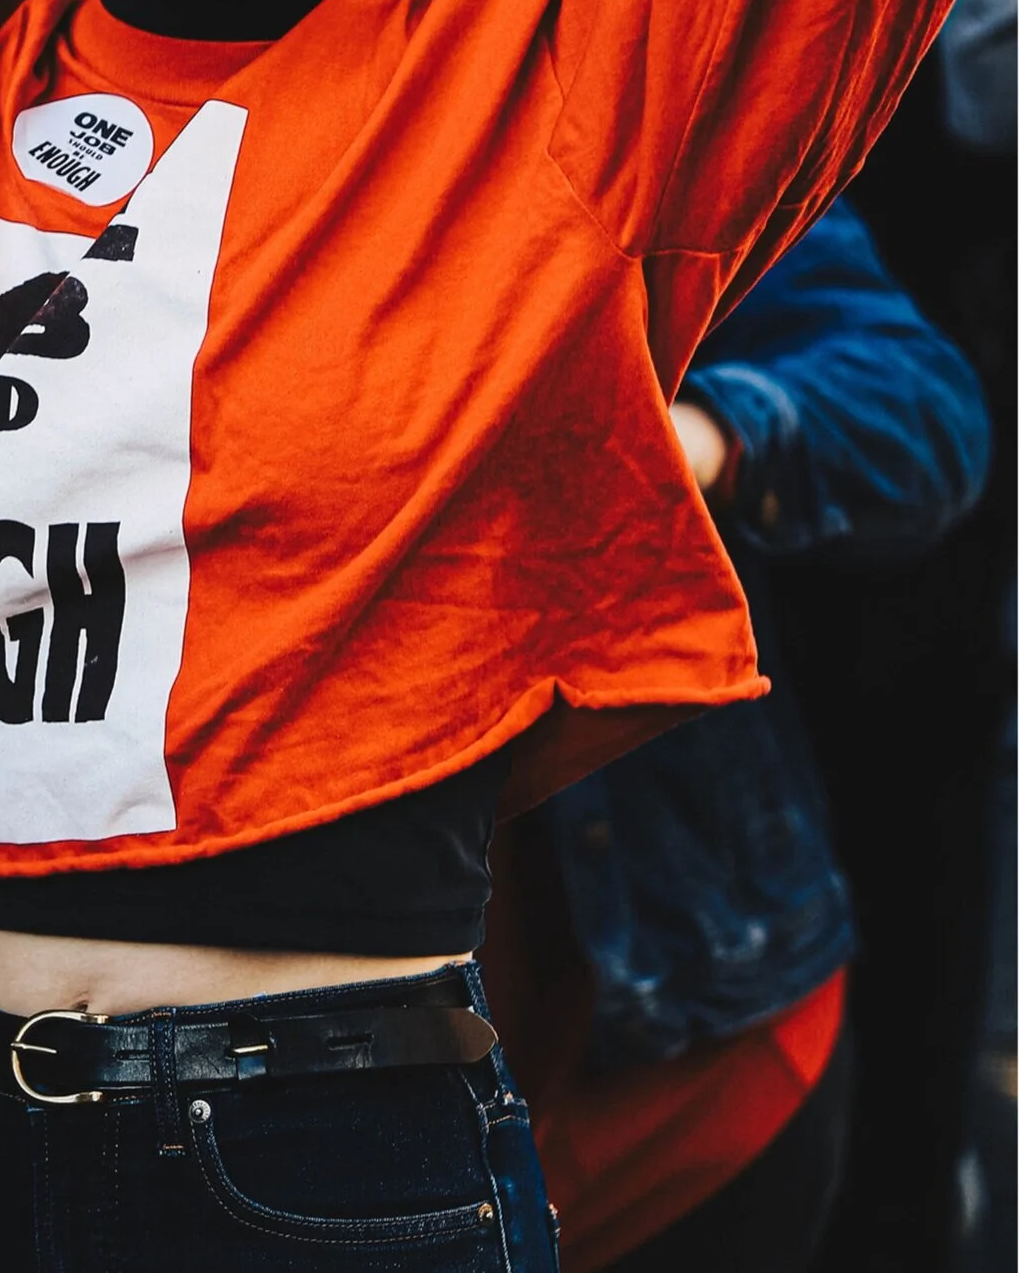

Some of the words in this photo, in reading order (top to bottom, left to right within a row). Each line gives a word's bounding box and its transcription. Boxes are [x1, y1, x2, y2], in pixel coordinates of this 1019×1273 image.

[69, 130, 117, 156] JOB
[74, 111, 134, 148] ONE
[28, 140, 101, 192] ENOUGH
